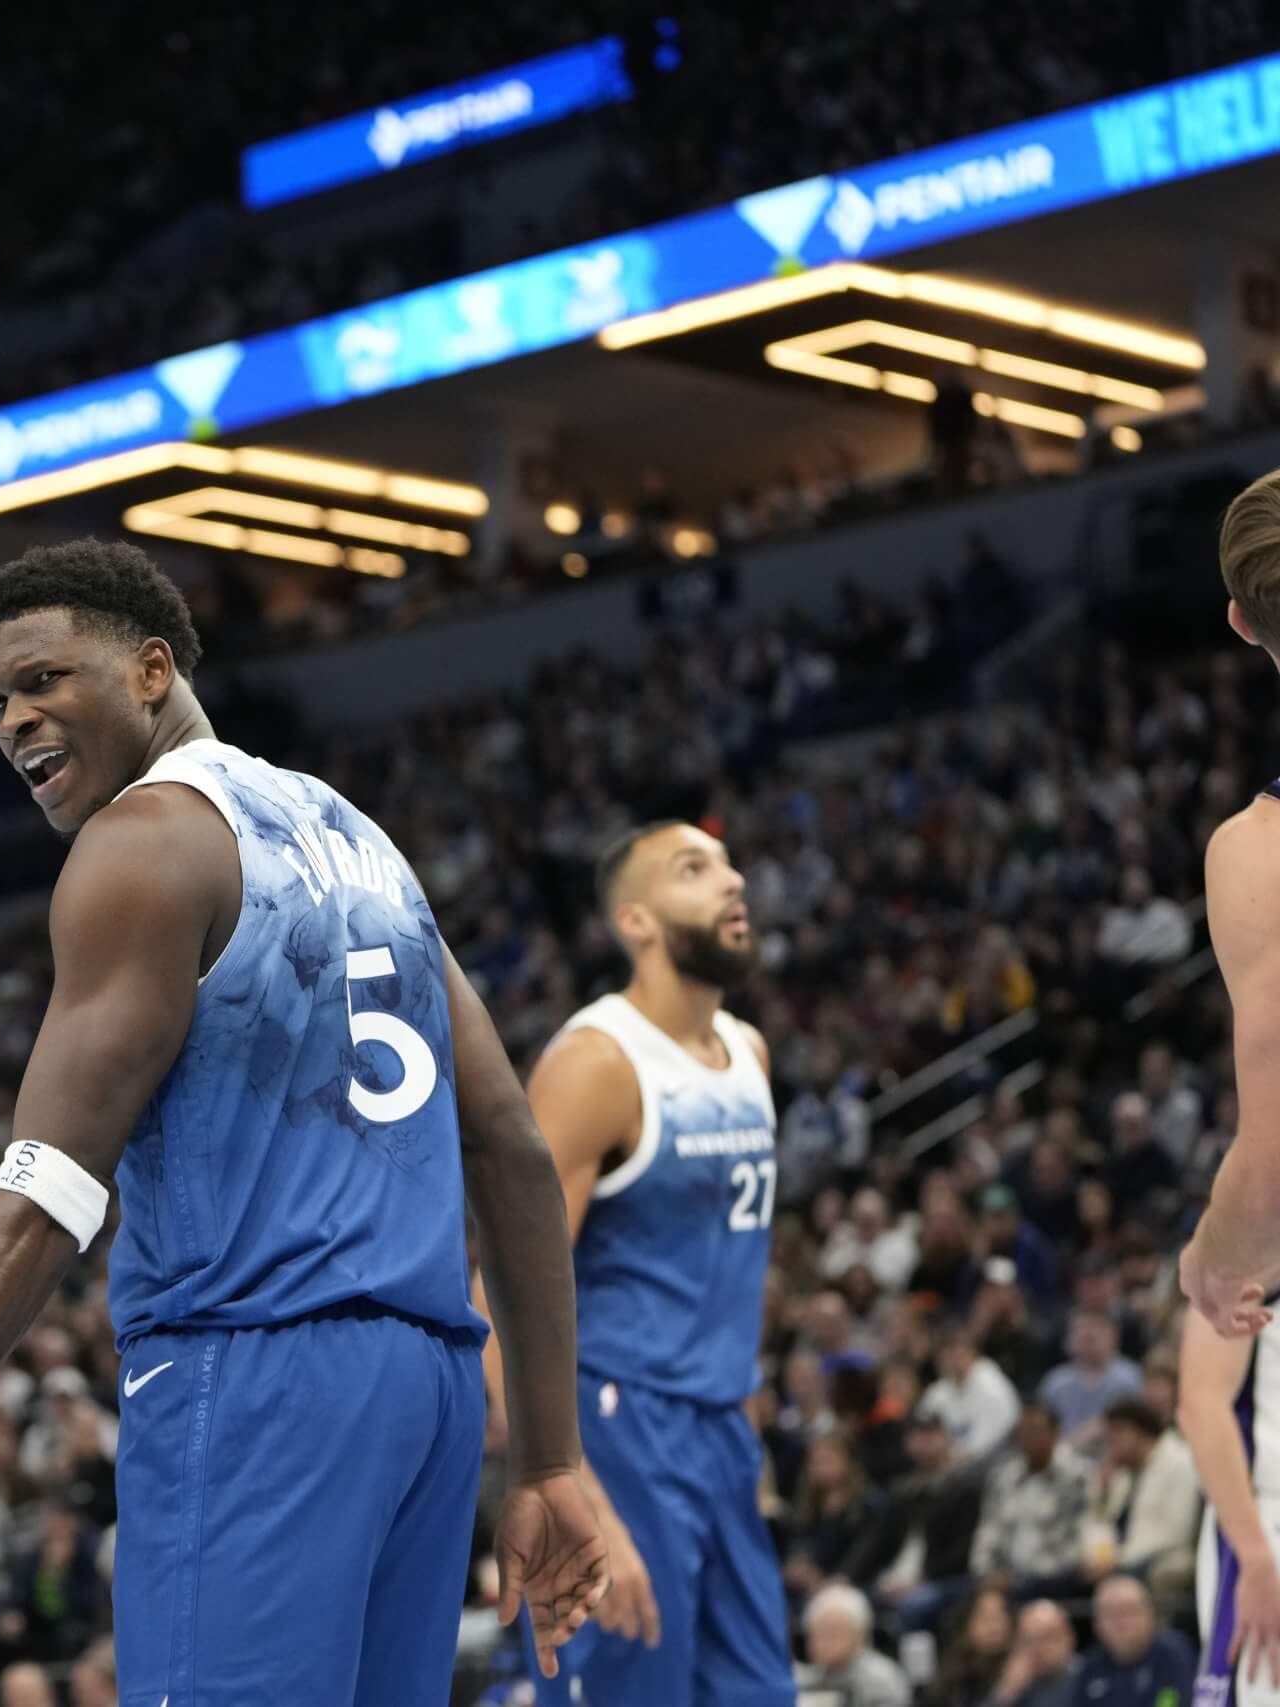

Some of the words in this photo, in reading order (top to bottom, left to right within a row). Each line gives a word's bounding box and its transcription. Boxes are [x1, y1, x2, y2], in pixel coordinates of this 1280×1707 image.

[1091, 92, 1174, 189] WE
[874, 144, 1054, 230] PENTAIR
[281, 820, 404, 907] EWRDS
[346, 946, 438, 1122] 5
[16, 1142, 41, 1167] 5
[728, 1159, 776, 1232] 27
[199, 1343, 216, 1392] LAKES
